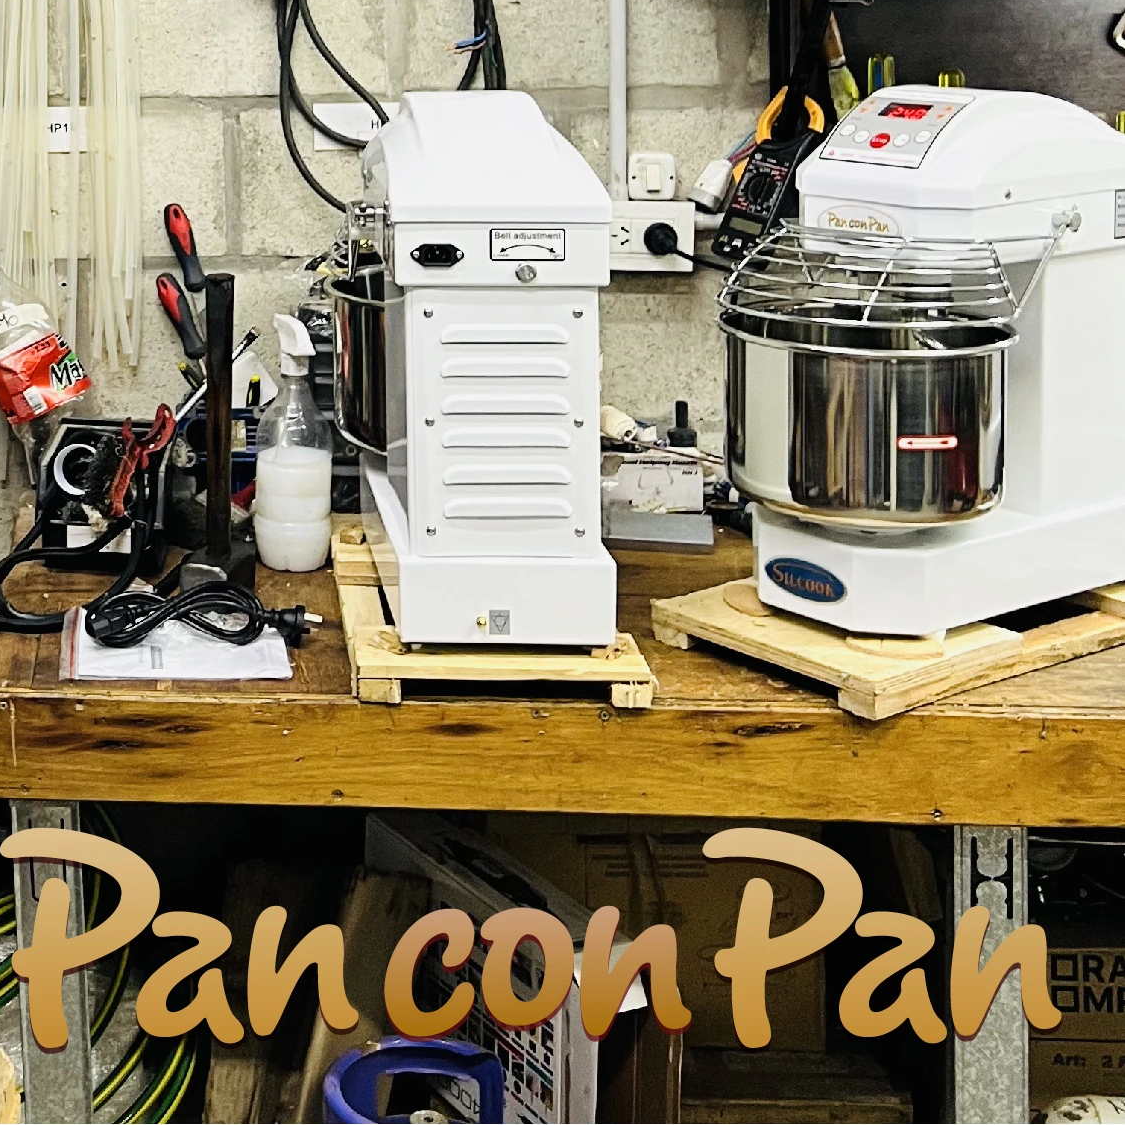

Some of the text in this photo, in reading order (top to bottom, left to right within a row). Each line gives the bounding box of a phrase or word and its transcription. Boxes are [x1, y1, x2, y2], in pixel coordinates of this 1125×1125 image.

[827, 211, 890, 233] Pan con Pan
[494, 231, 562, 242] Belt adjustment
